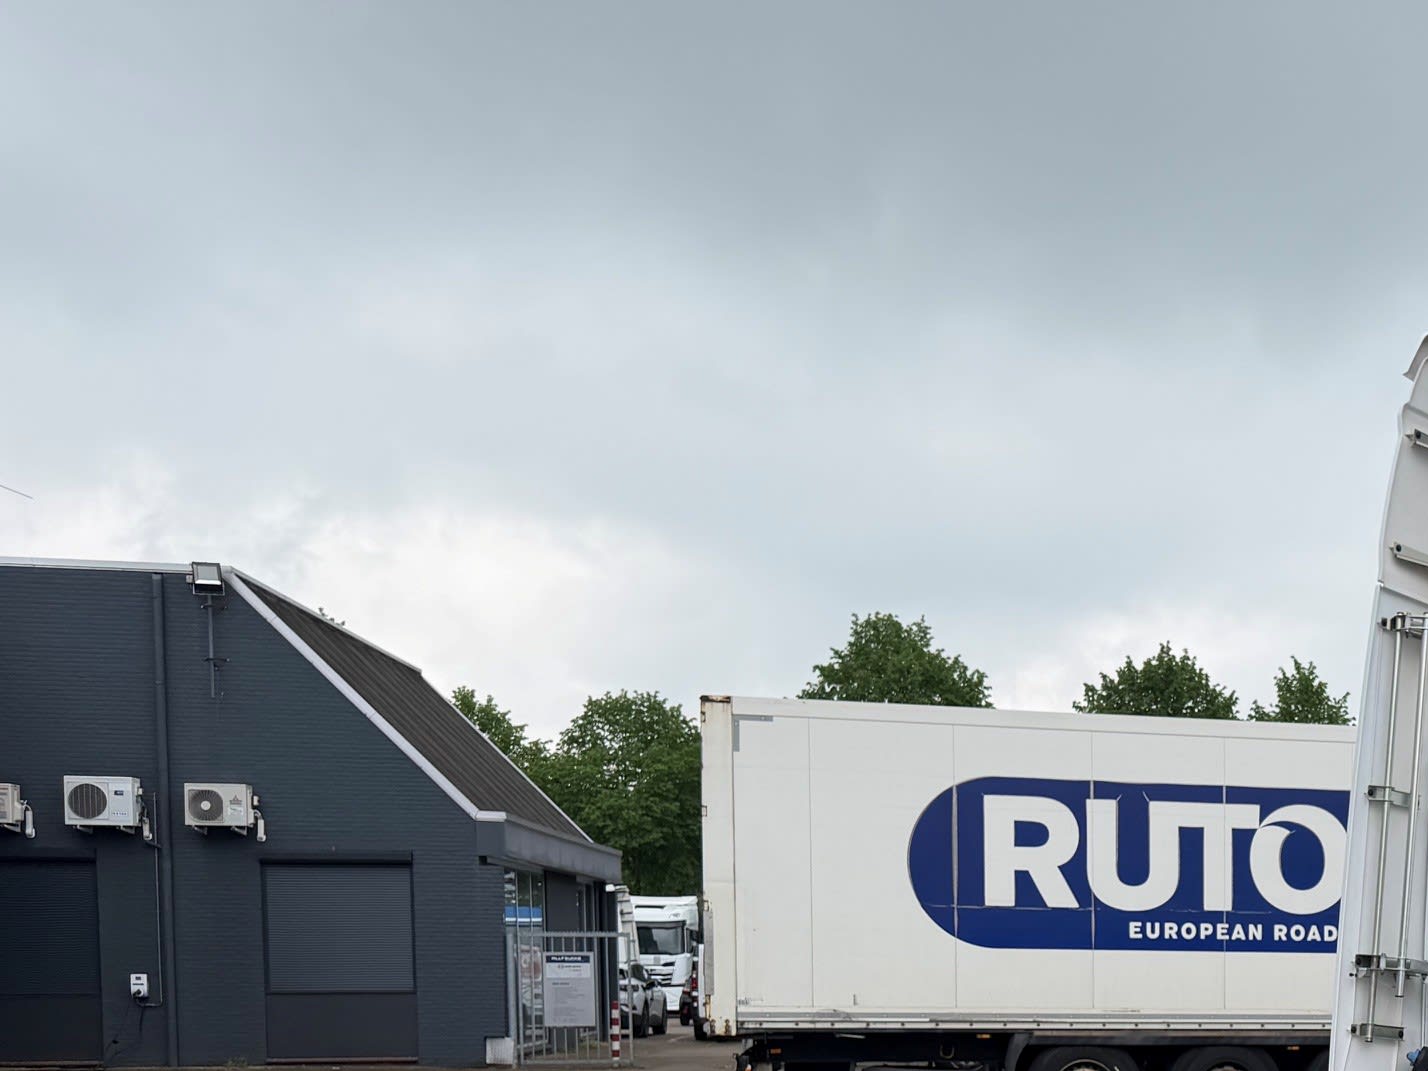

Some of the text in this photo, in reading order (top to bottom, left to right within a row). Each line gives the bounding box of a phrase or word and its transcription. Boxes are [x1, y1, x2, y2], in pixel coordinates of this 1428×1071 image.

[983, 795, 1347, 915] RUTO
[1128, 921, 1338, 942] EUROPEAN ROAD
